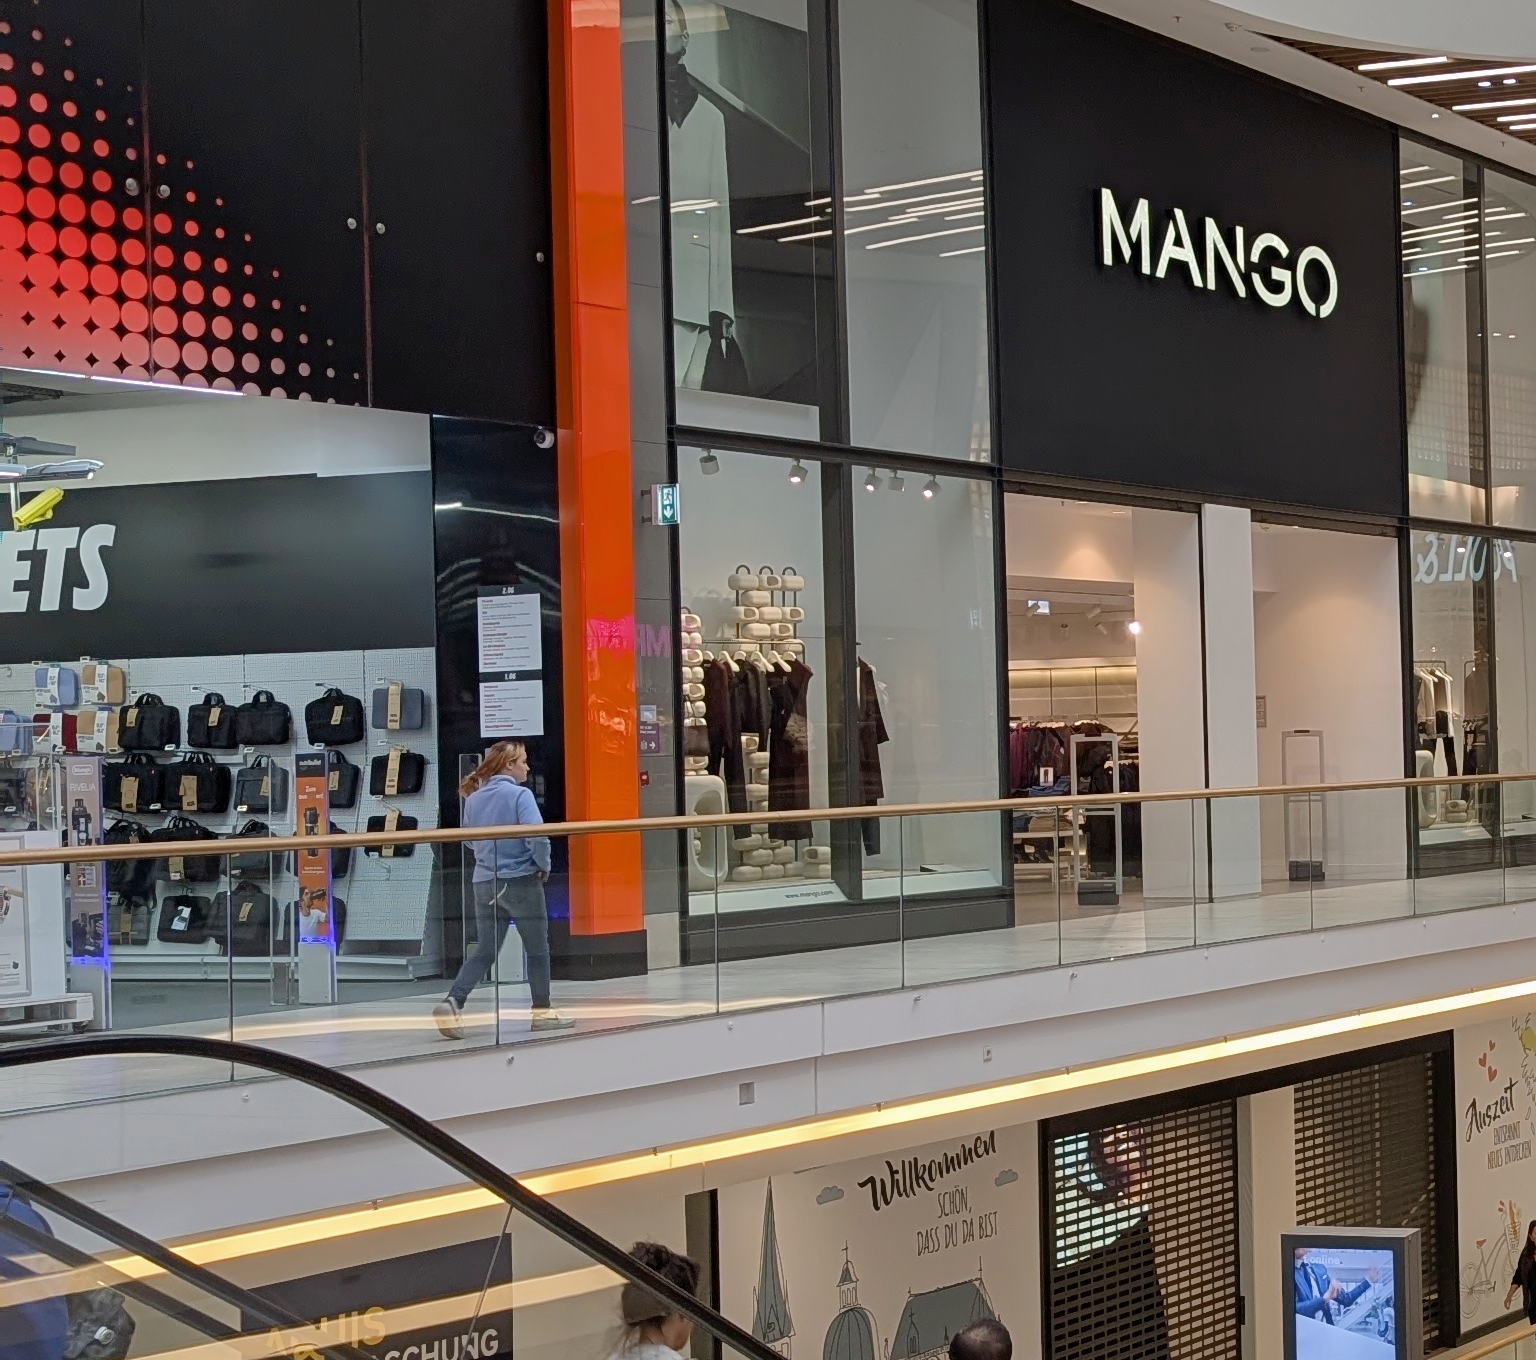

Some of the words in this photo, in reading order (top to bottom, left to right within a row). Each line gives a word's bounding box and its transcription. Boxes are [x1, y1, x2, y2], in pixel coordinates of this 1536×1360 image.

[1101, 187, 1338, 319] MANGO
[1465, 1077, 1519, 1142] Auszeit
[857, 1130, 996, 1211] Willkommen
[938, 1184, 972, 1218] SCHÖN,
[916, 1226, 941, 1256] DASS
[944, 1222, 958, 1249] DU
[962, 1218, 975, 1245] DA
[978, 1211, 998, 1240] BIST
